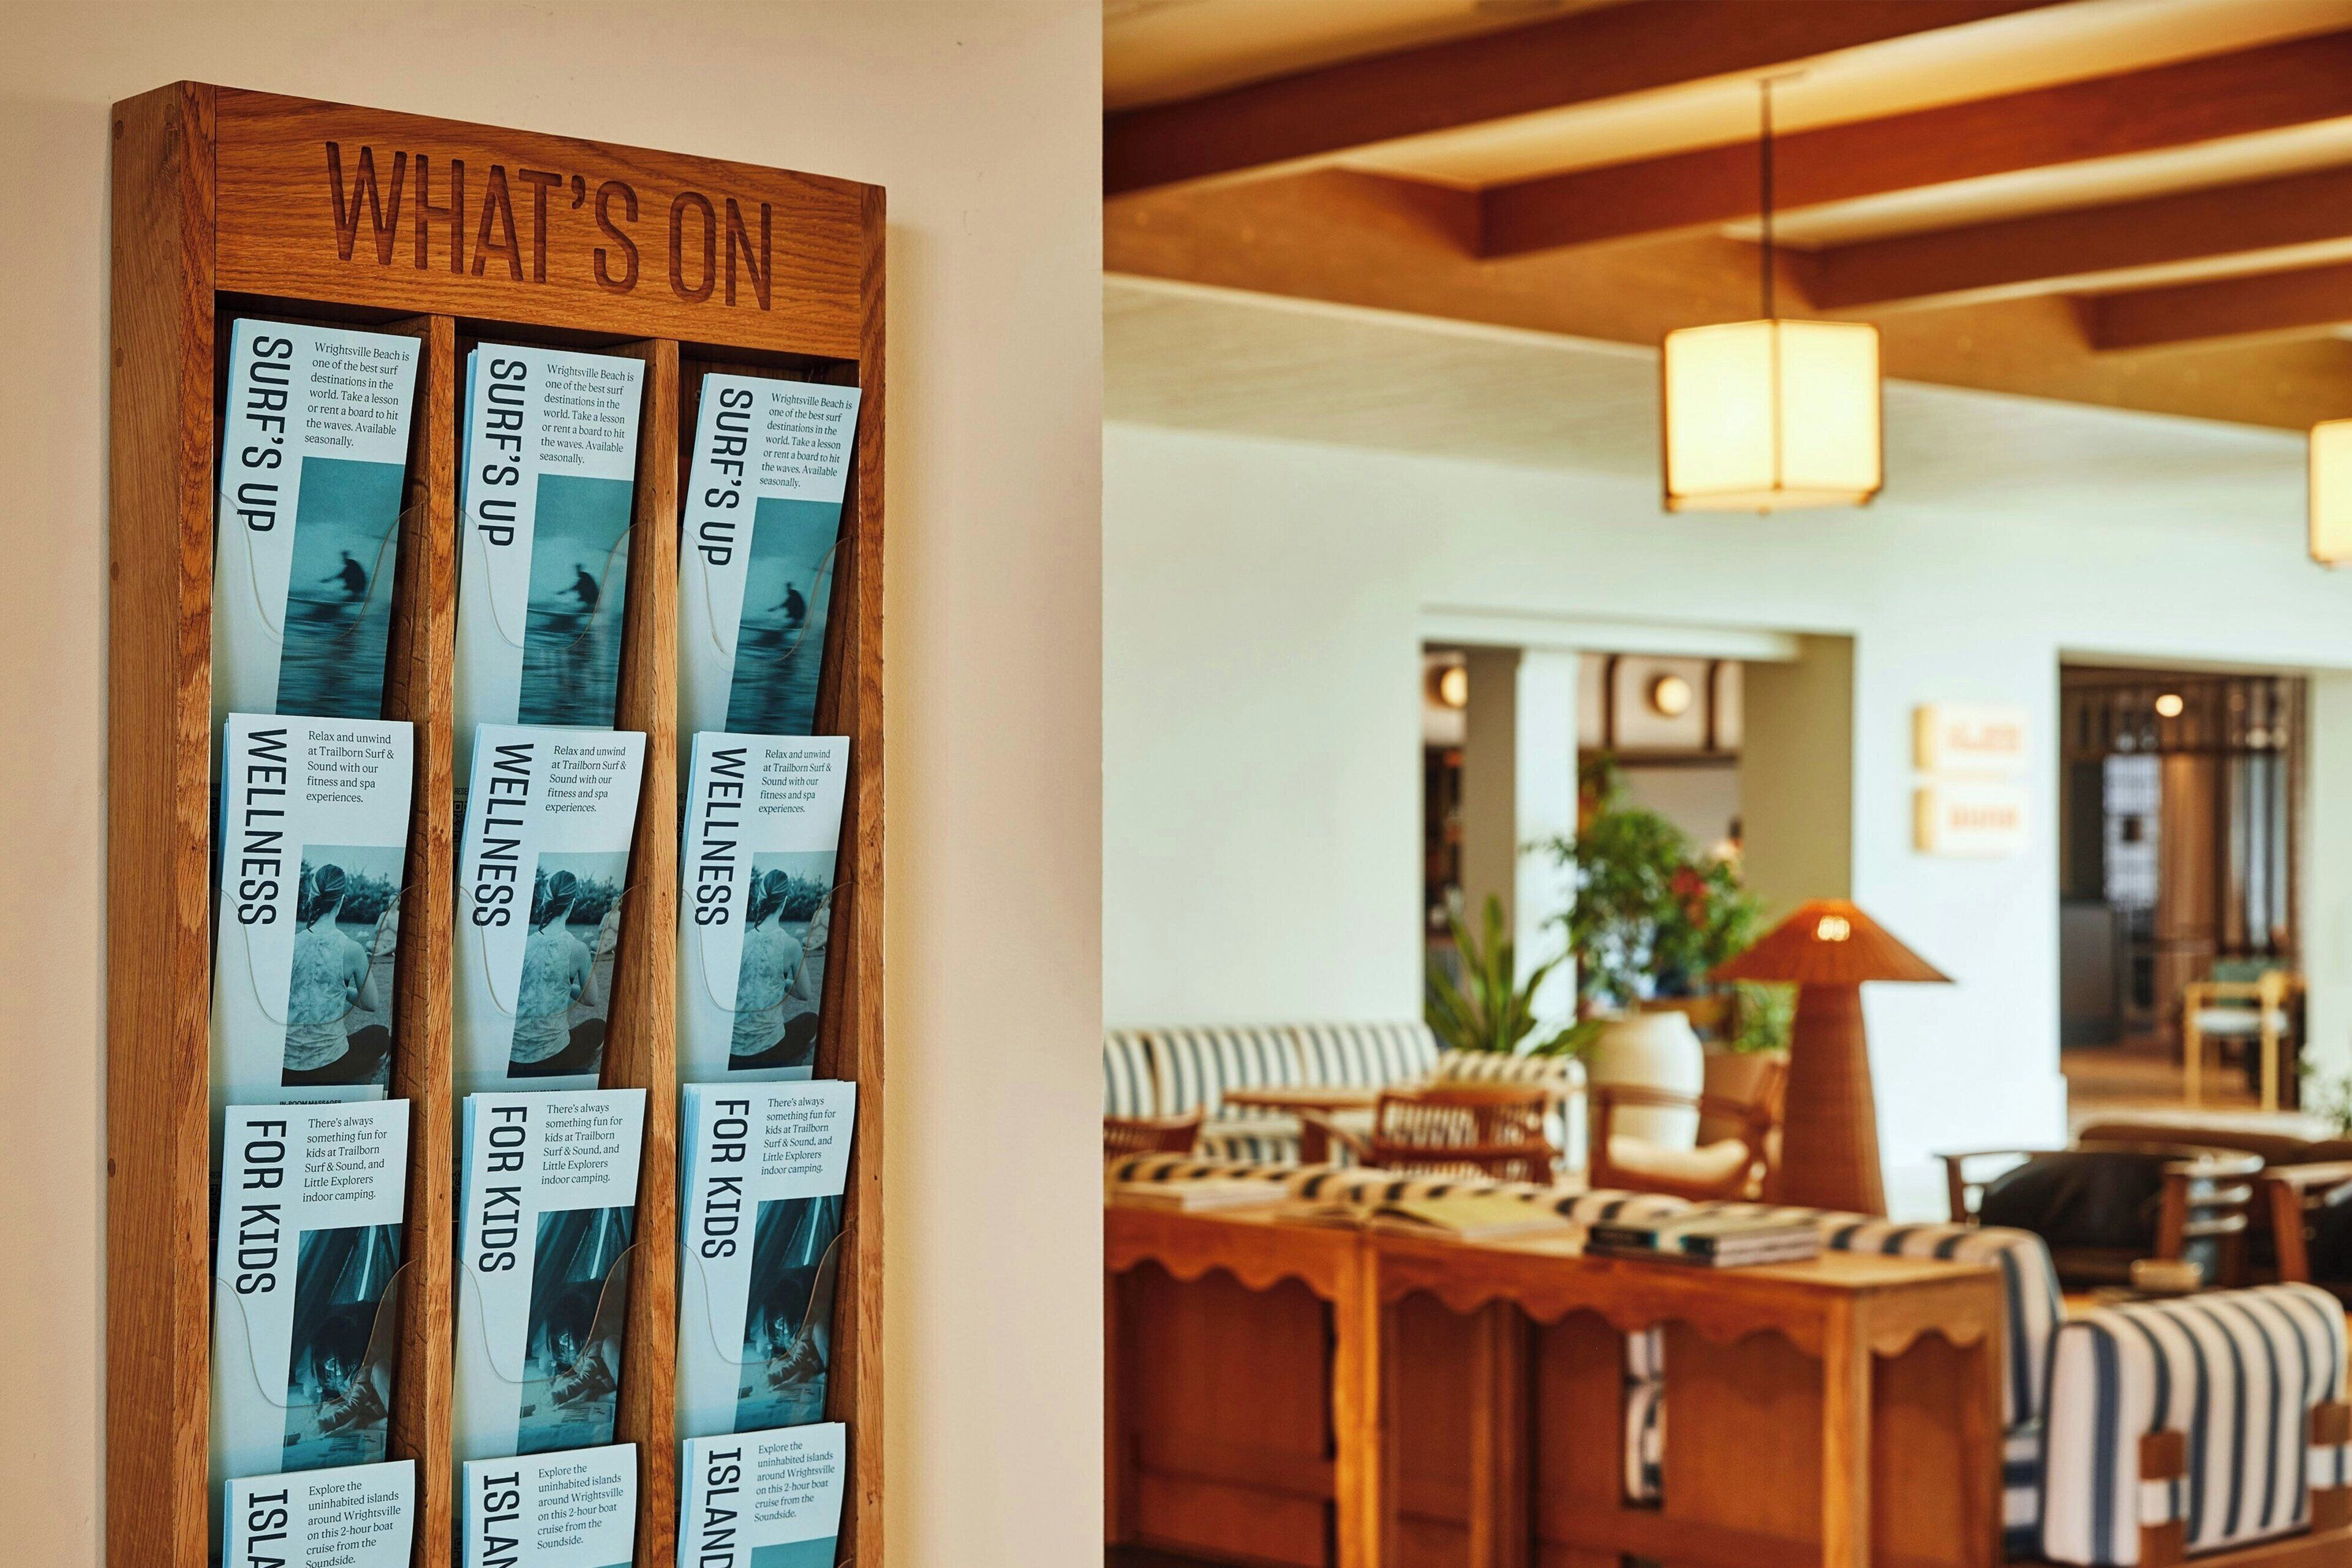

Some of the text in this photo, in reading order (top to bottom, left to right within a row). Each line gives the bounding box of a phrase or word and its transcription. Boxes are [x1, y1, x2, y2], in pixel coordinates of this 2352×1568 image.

[325, 141, 772, 311] WHAT'S ON
[315, 342, 409, 361] Wrightsville Beach is
[311, 358, 399, 375] one of the best surf
[311, 372, 393, 390] destinations in the
[309, 389, 338, 399] world.
[341, 390, 363, 402] Take
[371, 393, 398, 405] lesson
[320, 406, 339, 415] rent
[348, 406, 374, 418] board
[375, 410, 384, 419] to
[386, 409, 398, 420] hit
[237, 336, 293, 531] SURF'S UP
[306, 417, 396, 435] the waves. Available
[304, 435, 353, 448] seasonally.
[478, 360, 527, 546] SURF'S UP
[698, 389, 753, 565] SURF'S UP
[308, 730, 391, 744] Relax and unwind
[318, 745, 364, 757] Trailborn
[365, 748, 385, 758] Surf
[386, 749, 394, 759] &
[554, 745, 625, 756] Relax and unwind
[307, 760, 337, 771] Sound
[339, 762, 360, 772] with
[562, 760, 600, 769] Trailborn
[601, 760, 620, 770] Surf
[620, 761, 627, 770] &
[307, 775, 375, 790] fitness and spa
[549, 773, 577, 783] Sound
[579, 774, 597, 783] with
[306, 791, 363, 803] experiences.
[547, 787, 608, 800] fitness and spa
[545, 802, 596, 813] experiences.
[238, 729, 287, 924] WELLNESS
[472, 744, 534, 927] WELLNESS
[695, 748, 747, 925] WELLNESS
[767, 1097, 824, 1107] There's always
[307, 1117, 373, 1128] There's always
[766, 1109, 836, 1121] something fun for
[306, 1129, 387, 1143] something fun for
[765, 1125, 782, 1134] kids
[793, 1123, 828, 1133] Trailborn
[763, 1136, 832, 1148] Surf & Sound, and
[306, 1147, 325, 1158] kids
[338, 1145, 379, 1156] Trailborn
[763, 1150, 821, 1161] Little Explorers
[304, 1158, 384, 1172] Surf & Sound, and
[761, 1163, 823, 1175] indoor camping.
[304, 1175, 373, 1188] Little Explorers
[701, 1101, 749, 1258] FOR KIDS
[303, 1189, 375, 1202] indoor camping.
[479, 1107, 527, 1272] FOR KIDS
[236, 1121, 287, 1294] FOR KIDS
[758, 1441, 802, 1455] Explore the
[758, 1451, 833, 1468] uninhabited islands
[538, 1464, 587, 1479] Explore the
[756, 1464, 835, 1481] around Wrightsville
[309, 1481, 362, 1496] Explore the
[538, 1473, 621, 1493] uninhabited islands
[767, 1483, 783, 1493] this
[784, 1482, 810, 1491] 2-hour
[811, 1479, 828, 1488] boat
[308, 1491, 399, 1510] uninhabited islands
[538, 1487, 623, 1507] around Wrightsville
[755, 1494, 814, 1509] cruise from the
[307, 1505, 401, 1526] around Wrightsville
[551, 1509, 567, 1519] this
[568, 1506, 597, 1517] 2-hour
[598, 1504, 616, 1513] boat
[700, 1448, 741, 1568] ISLAND
[753, 1509, 796, 1522] Soundside.
[307, 1522, 393, 1540] on this 2-hour boat
[537, 1518, 601, 1536] cruise from the
[306, 1537, 376, 1555] cruise from the
[537, 1535, 583, 1549] Soundside.
[305, 1555, 355, 1568] Soundside.
